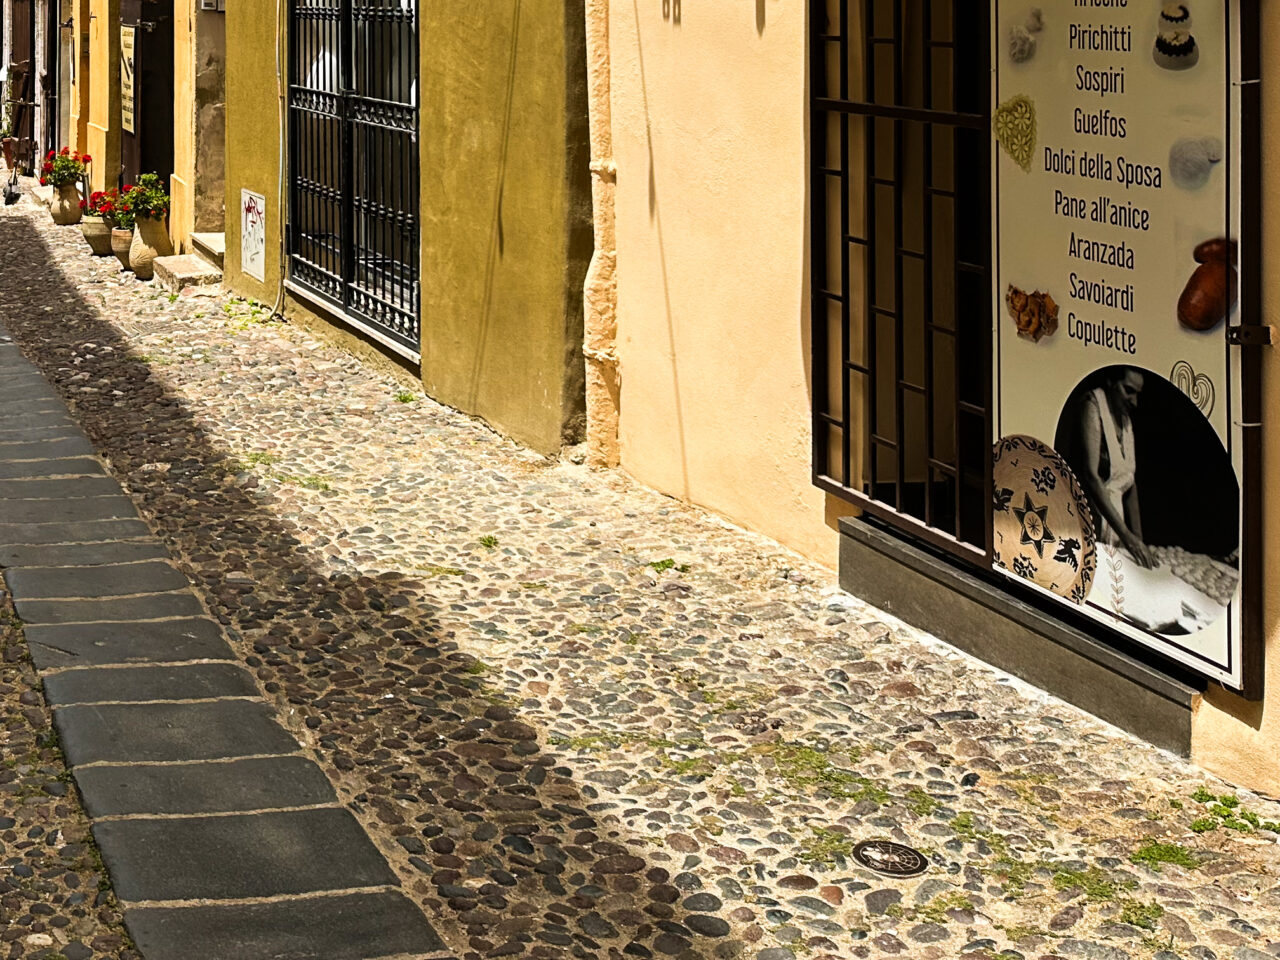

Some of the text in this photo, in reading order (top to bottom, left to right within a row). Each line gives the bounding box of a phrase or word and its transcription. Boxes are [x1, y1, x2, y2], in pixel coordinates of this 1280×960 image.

[1069, 24, 1132, 52] Pirichitti
[1076, 64, 1125, 97] Sospiri
[1074, 107, 1127, 139] Guelfos
[1044, 147, 1162, 190] Dolci della Sposa
[1055, 190, 1150, 231] Pane all'anice
[1068, 232, 1135, 270] Aranzada
[1069, 272, 1134, 313] Savoiardi
[1067, 312, 1137, 355] Copulette
